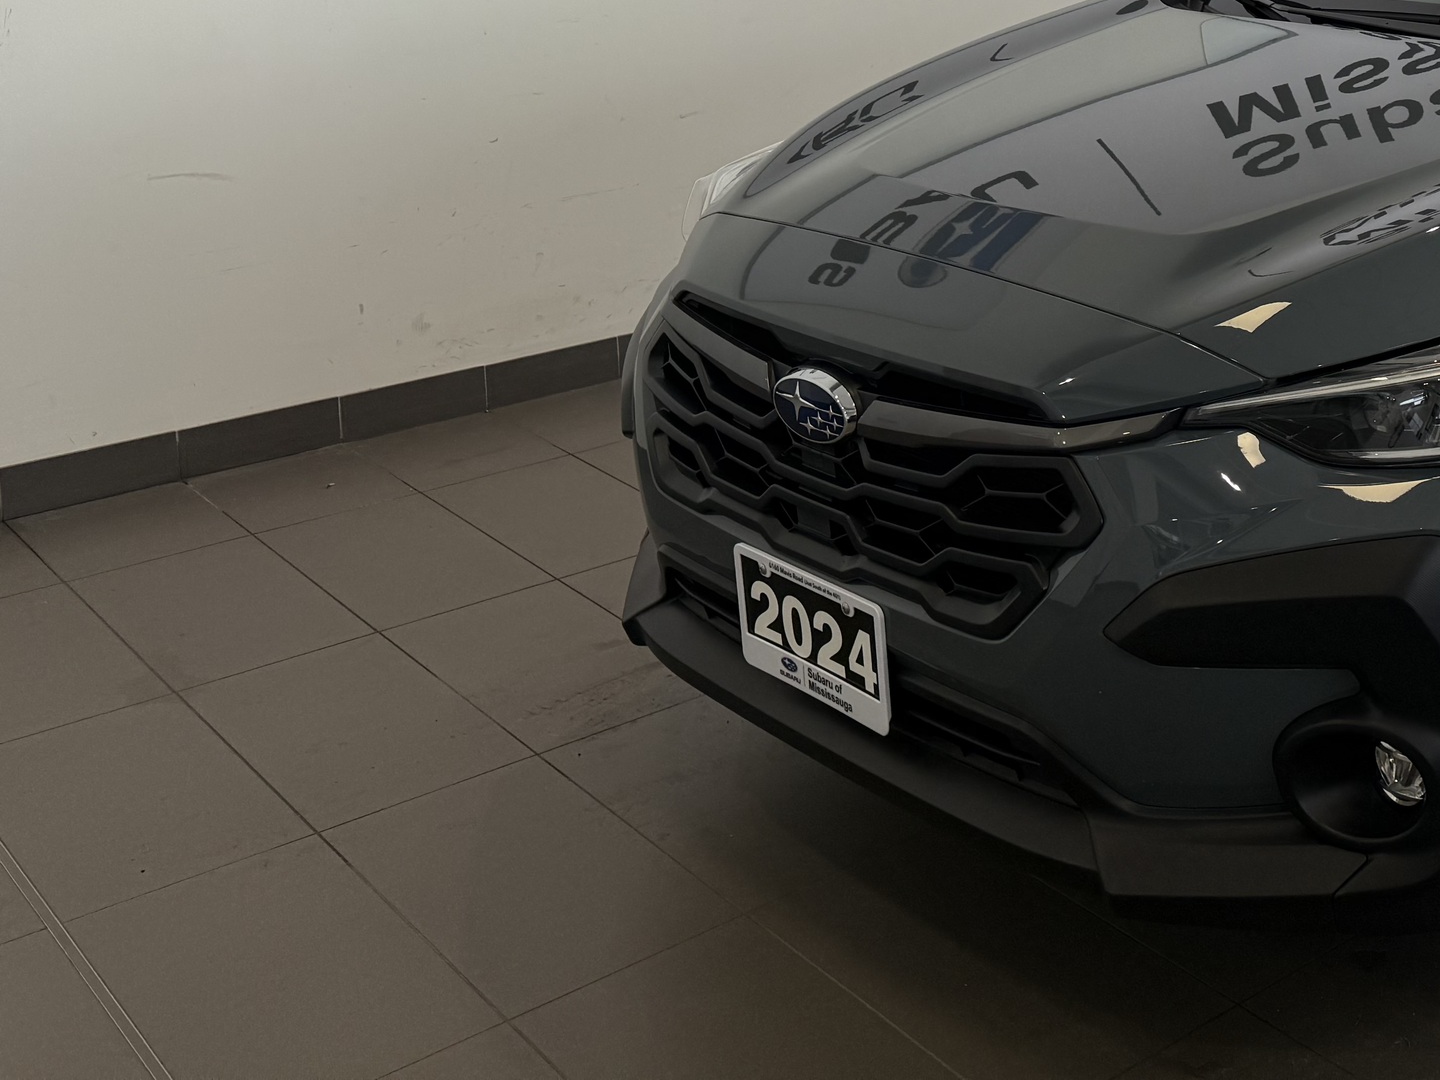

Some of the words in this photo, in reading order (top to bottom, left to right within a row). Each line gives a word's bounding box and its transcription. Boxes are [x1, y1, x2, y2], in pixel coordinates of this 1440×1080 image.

[793, 573, 804, 583] Road
[750, 580, 878, 695] 2024
[780, 669, 801, 684] SUBARU
[807, 667, 833, 690] Subaru
[834, 684, 842, 695] of
[808, 679, 853, 713] Mississauga
